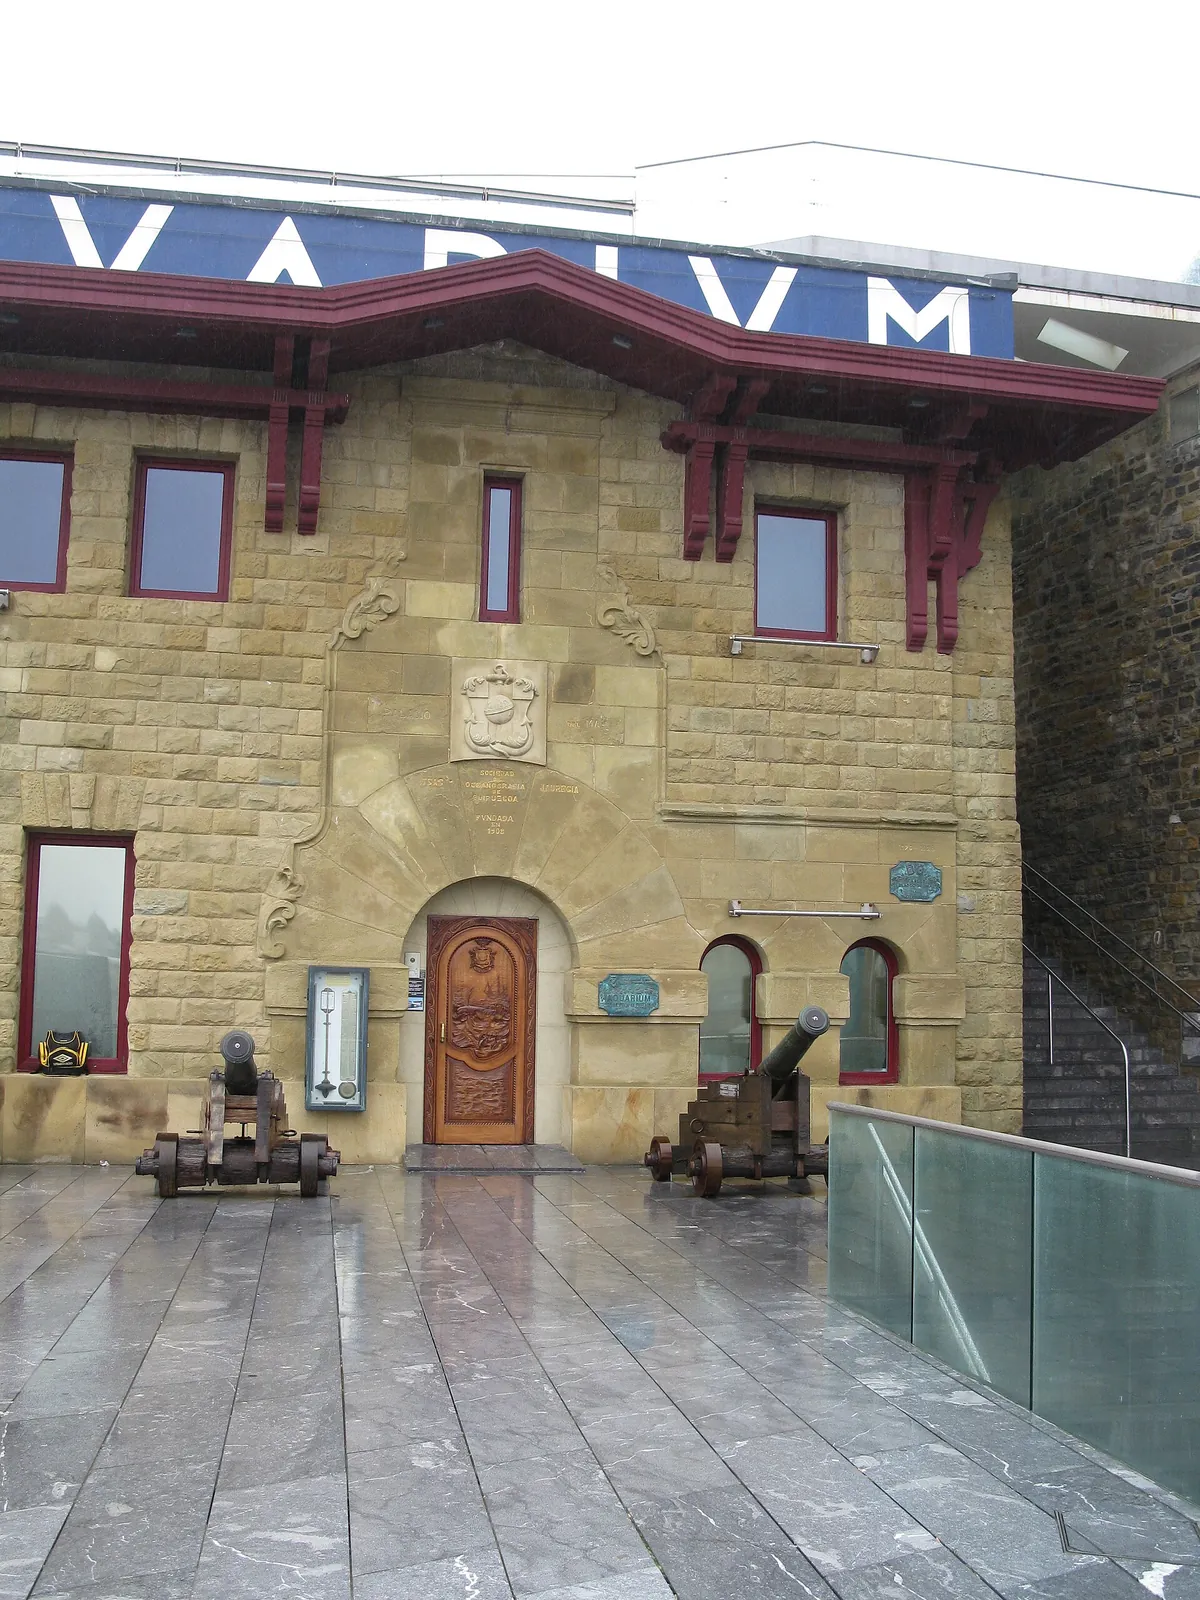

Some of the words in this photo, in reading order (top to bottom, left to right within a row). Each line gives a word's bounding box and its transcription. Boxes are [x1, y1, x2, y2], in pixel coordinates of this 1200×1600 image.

[480, 769, 515, 777] SOCIEDAD
[465, 782, 526, 791] OCEANOGRAFIA
[606, 993, 651, 1002] AQUARIUM
